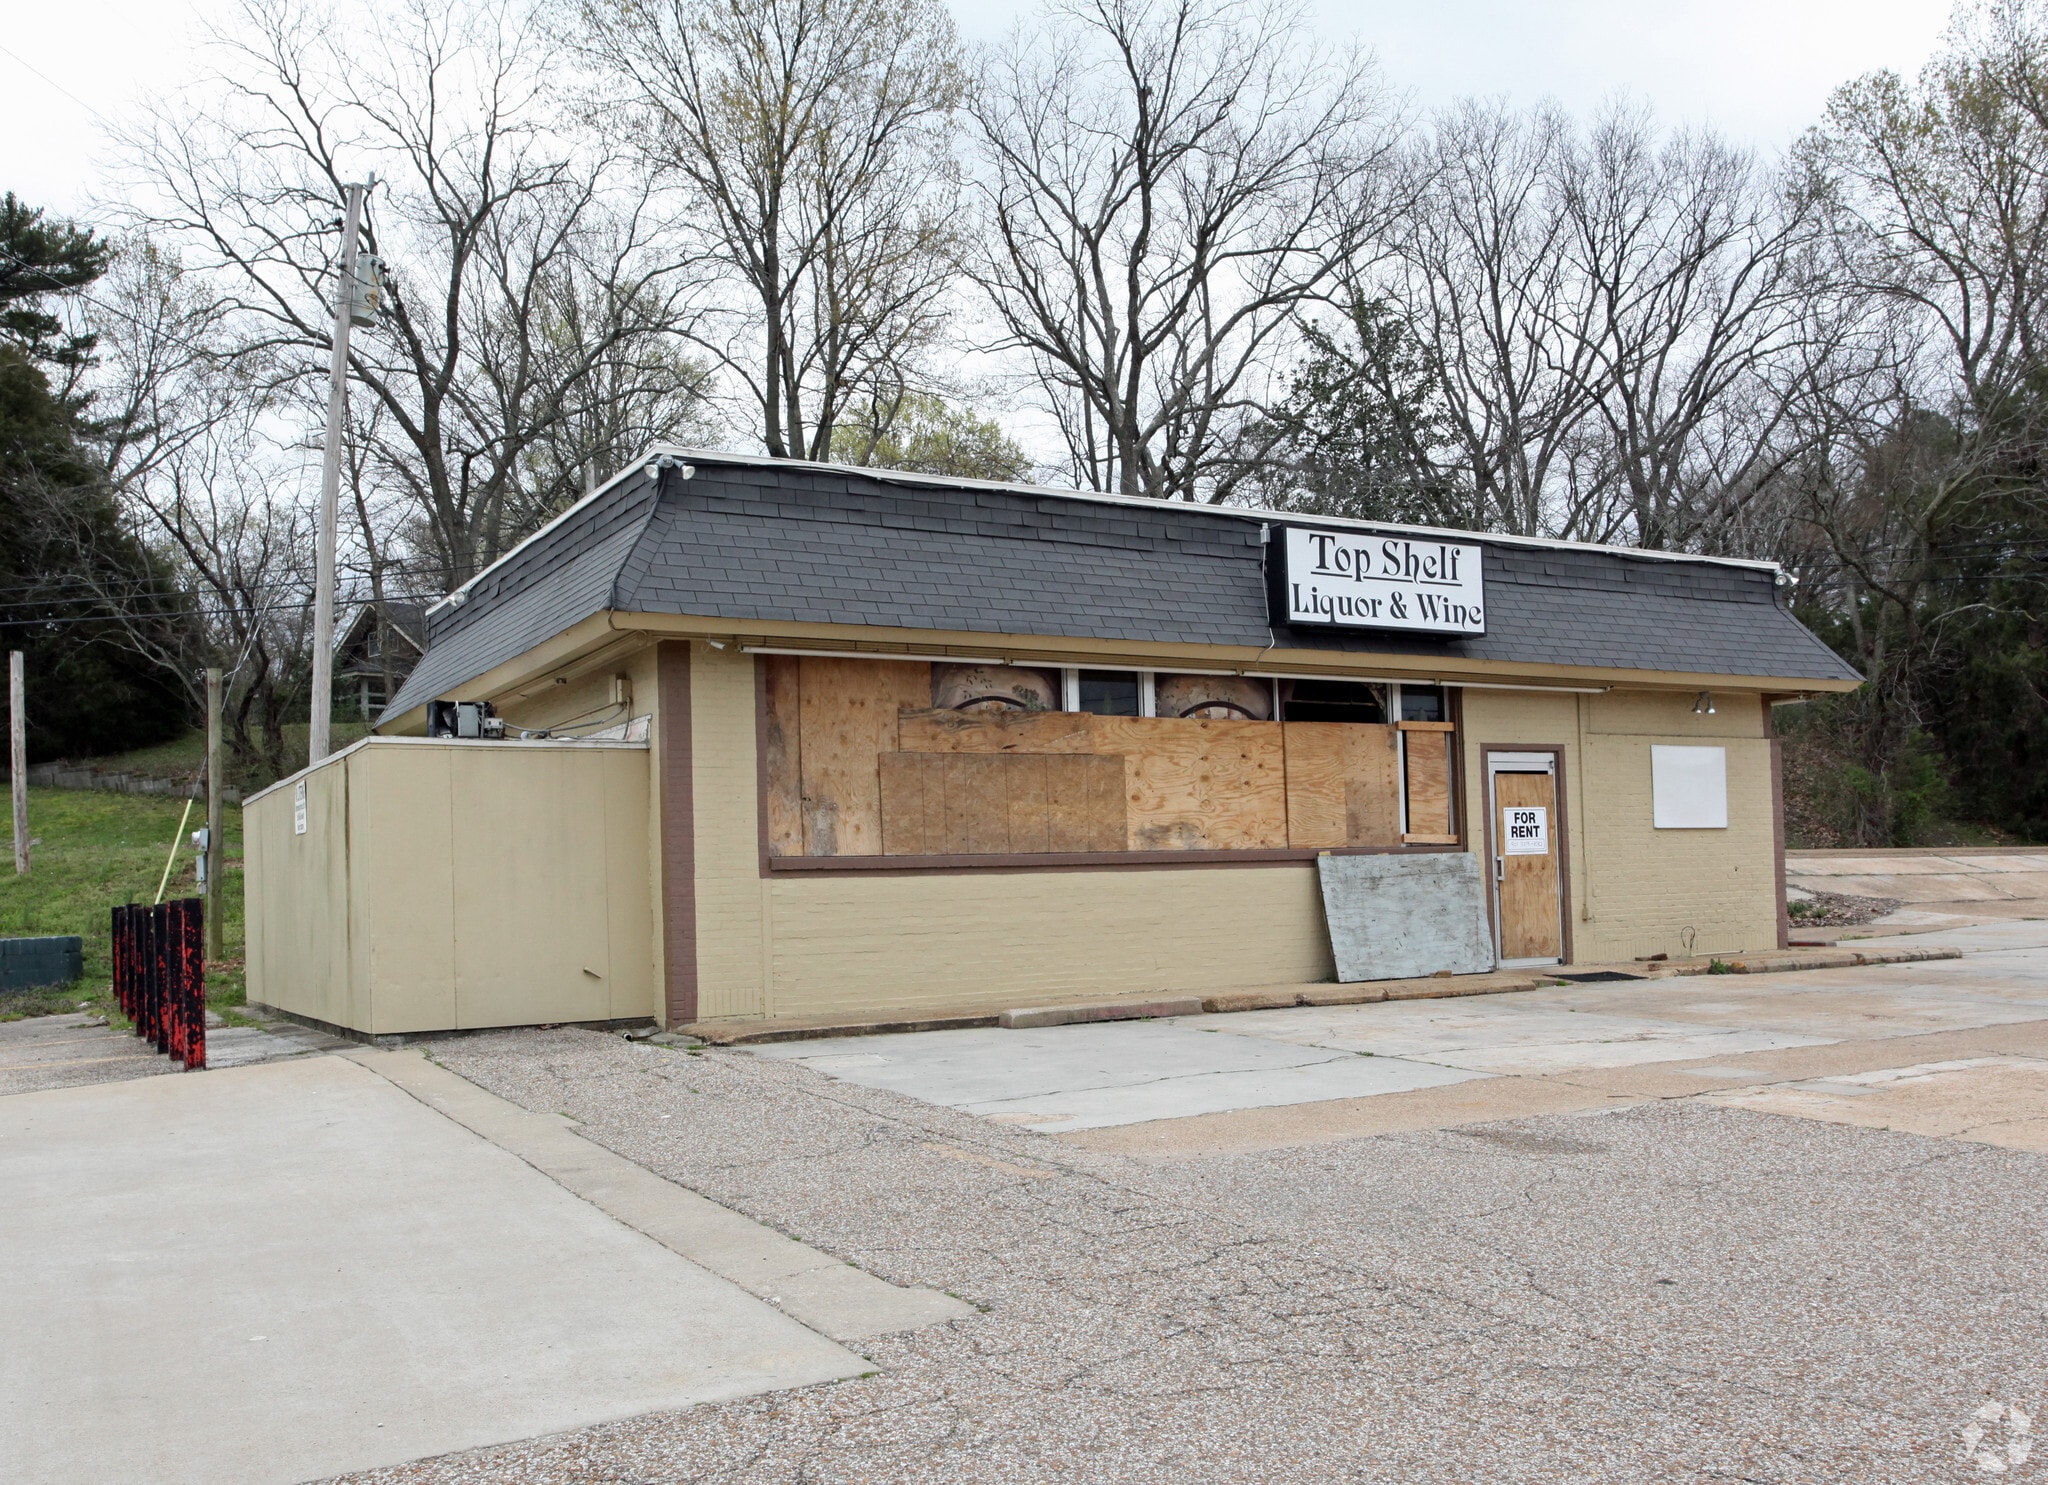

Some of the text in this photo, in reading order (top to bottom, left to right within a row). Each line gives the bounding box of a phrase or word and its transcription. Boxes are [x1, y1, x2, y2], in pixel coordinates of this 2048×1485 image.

[1309, 533, 1461, 584] Top Shelf
[1291, 583, 1482, 630] Liquor & Wine
[1511, 825, 1540, 838] RENT
[1514, 811, 1536, 824] FOR
